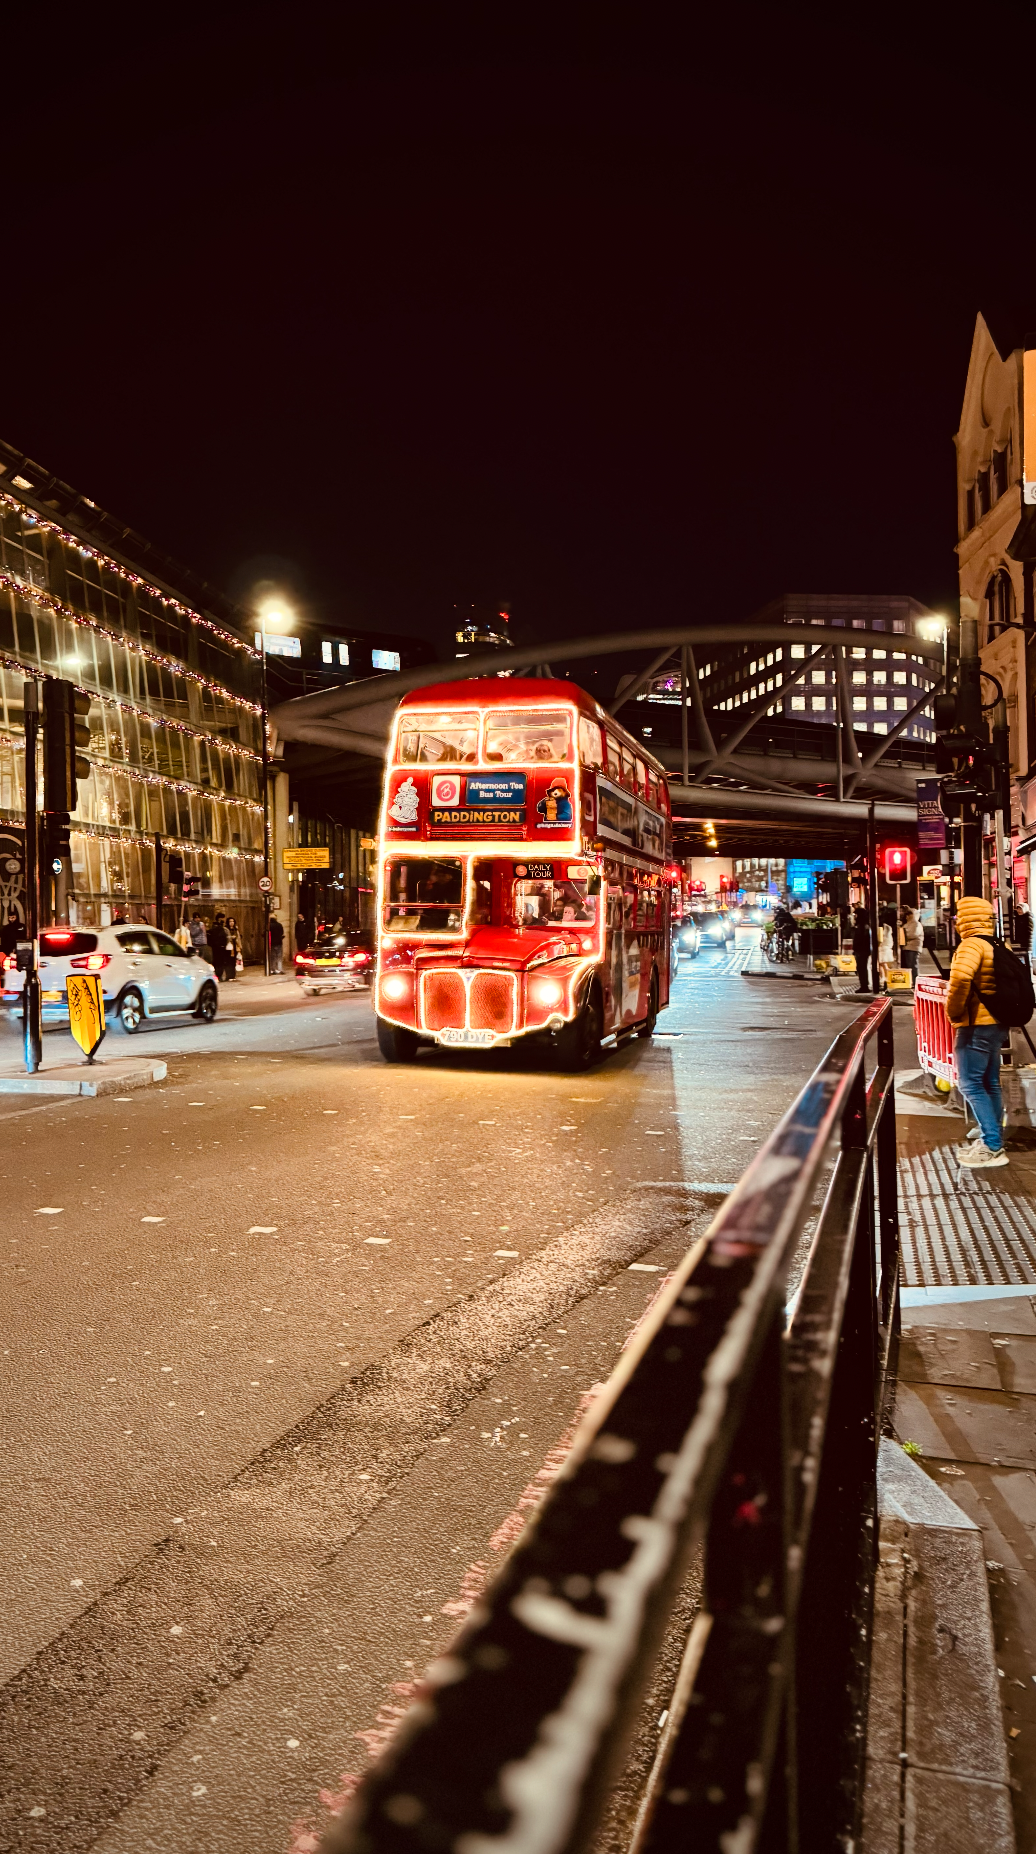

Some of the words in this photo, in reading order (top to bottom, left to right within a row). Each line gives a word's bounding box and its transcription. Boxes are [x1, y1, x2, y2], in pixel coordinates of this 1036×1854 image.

[470, 782, 509, 790] Afternoon
[510, 782, 524, 790] Tea
[528, 863, 552, 871] DAILY
[530, 870, 552, 878] TOUR
[260, 880, 271, 888] 20
[443, 1030, 465, 1042] 790
[468, 1030, 492, 1042] DYE
